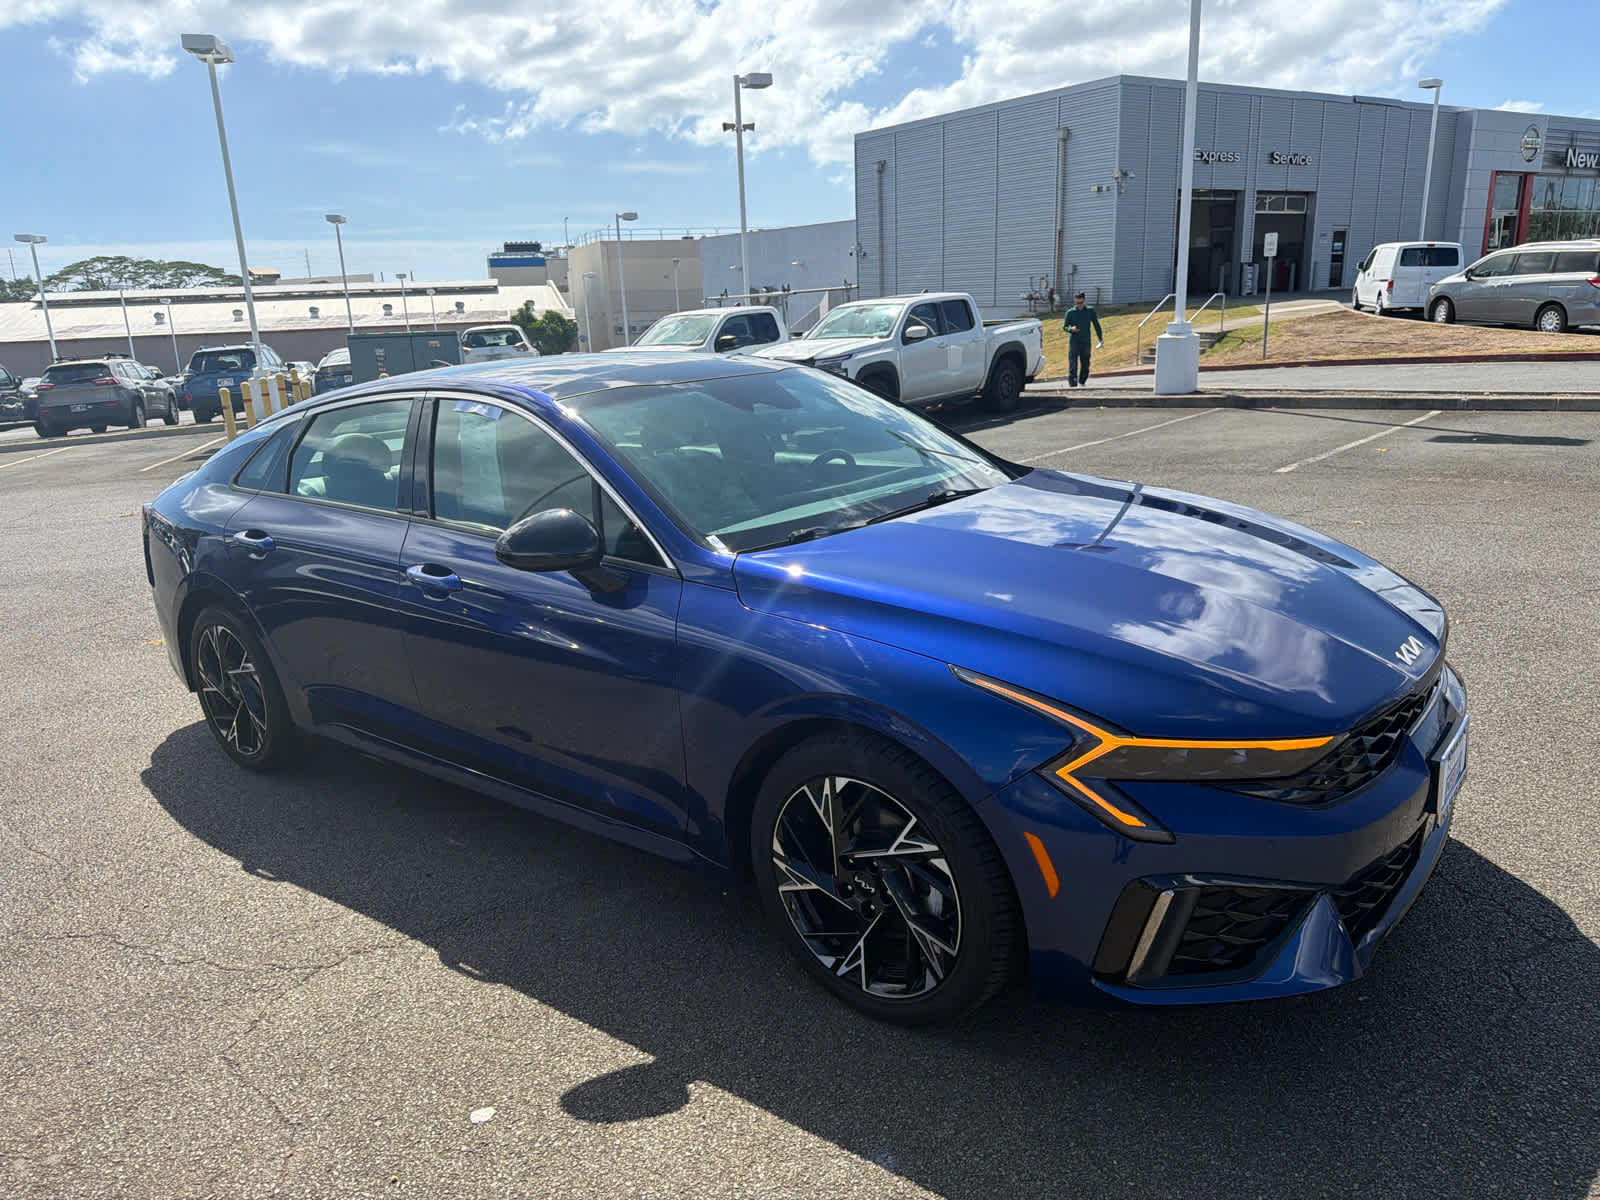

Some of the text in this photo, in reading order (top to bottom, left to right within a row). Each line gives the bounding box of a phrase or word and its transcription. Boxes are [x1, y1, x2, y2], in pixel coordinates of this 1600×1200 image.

[1194, 148, 1313, 165] Express Service
[1566, 147, 1599, 168] New
